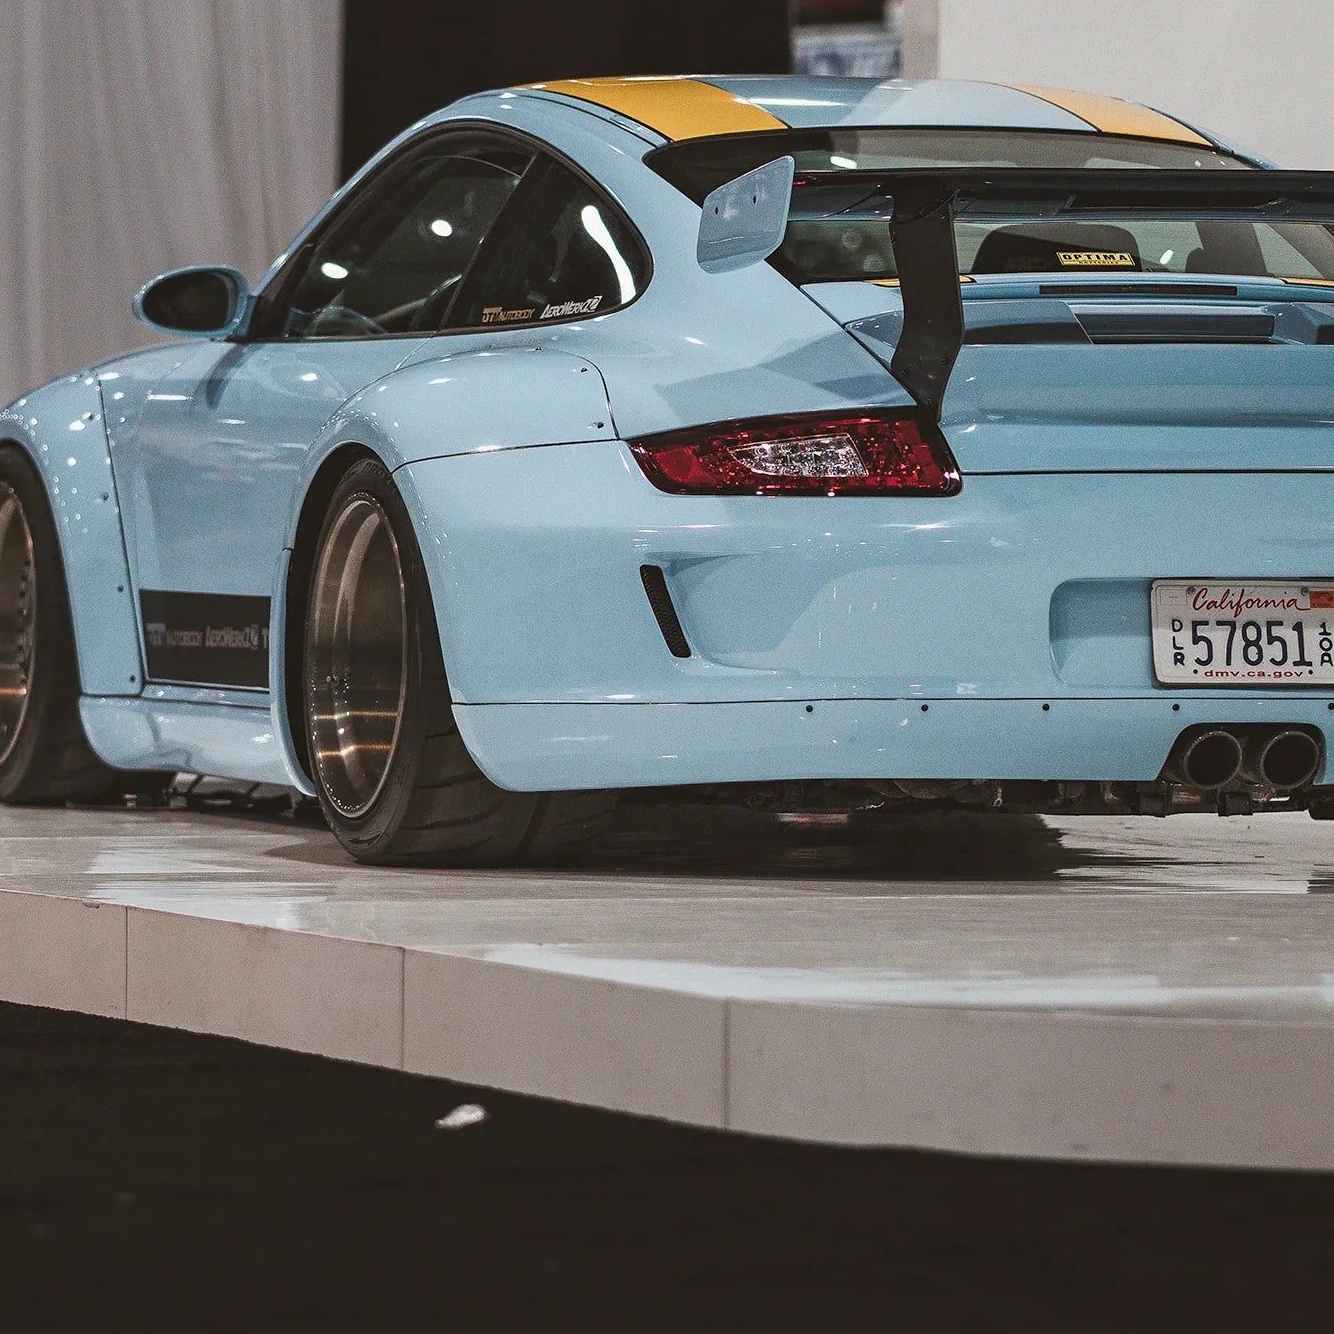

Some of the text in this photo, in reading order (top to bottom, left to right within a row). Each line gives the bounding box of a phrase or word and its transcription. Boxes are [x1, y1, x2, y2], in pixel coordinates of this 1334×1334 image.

[1192, 587, 1311, 618] California
[1191, 620, 1313, 667] 57851
[1204, 669, 1304, 678] dmv.ca.gov
